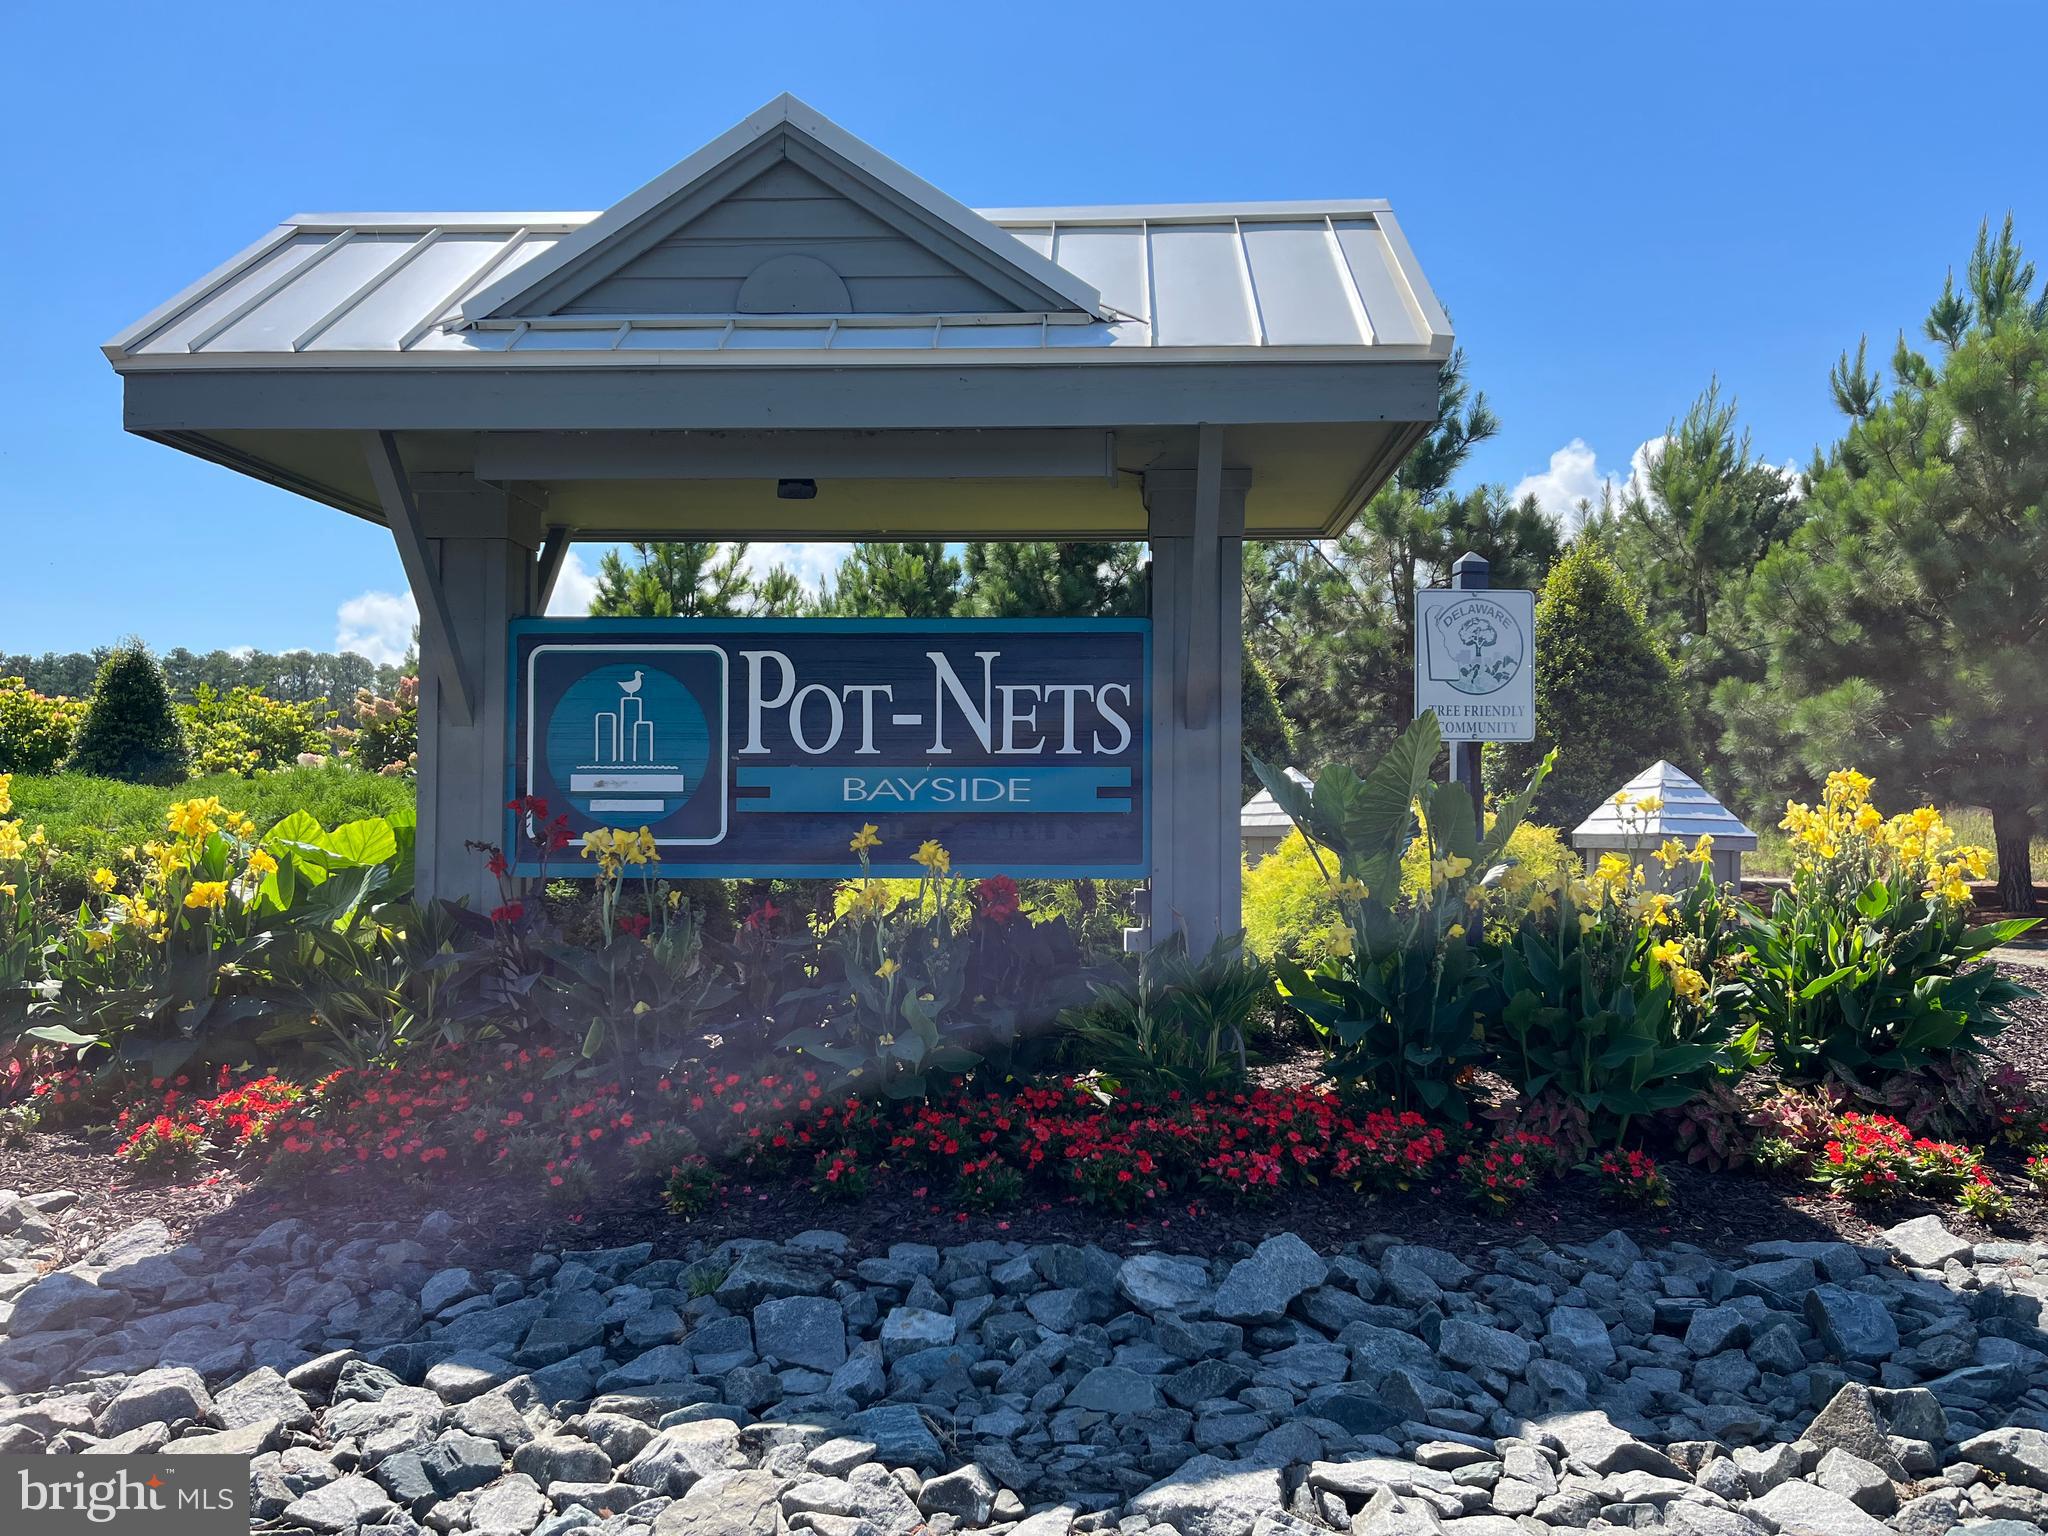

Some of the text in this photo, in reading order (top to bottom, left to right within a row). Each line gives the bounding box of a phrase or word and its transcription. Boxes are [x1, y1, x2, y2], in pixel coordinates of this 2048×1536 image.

[1443, 604, 1512, 630] DELAWARE
[1464, 704, 1525, 717] FRIENDLY
[843, 777, 1031, 803] BAYSIDE
